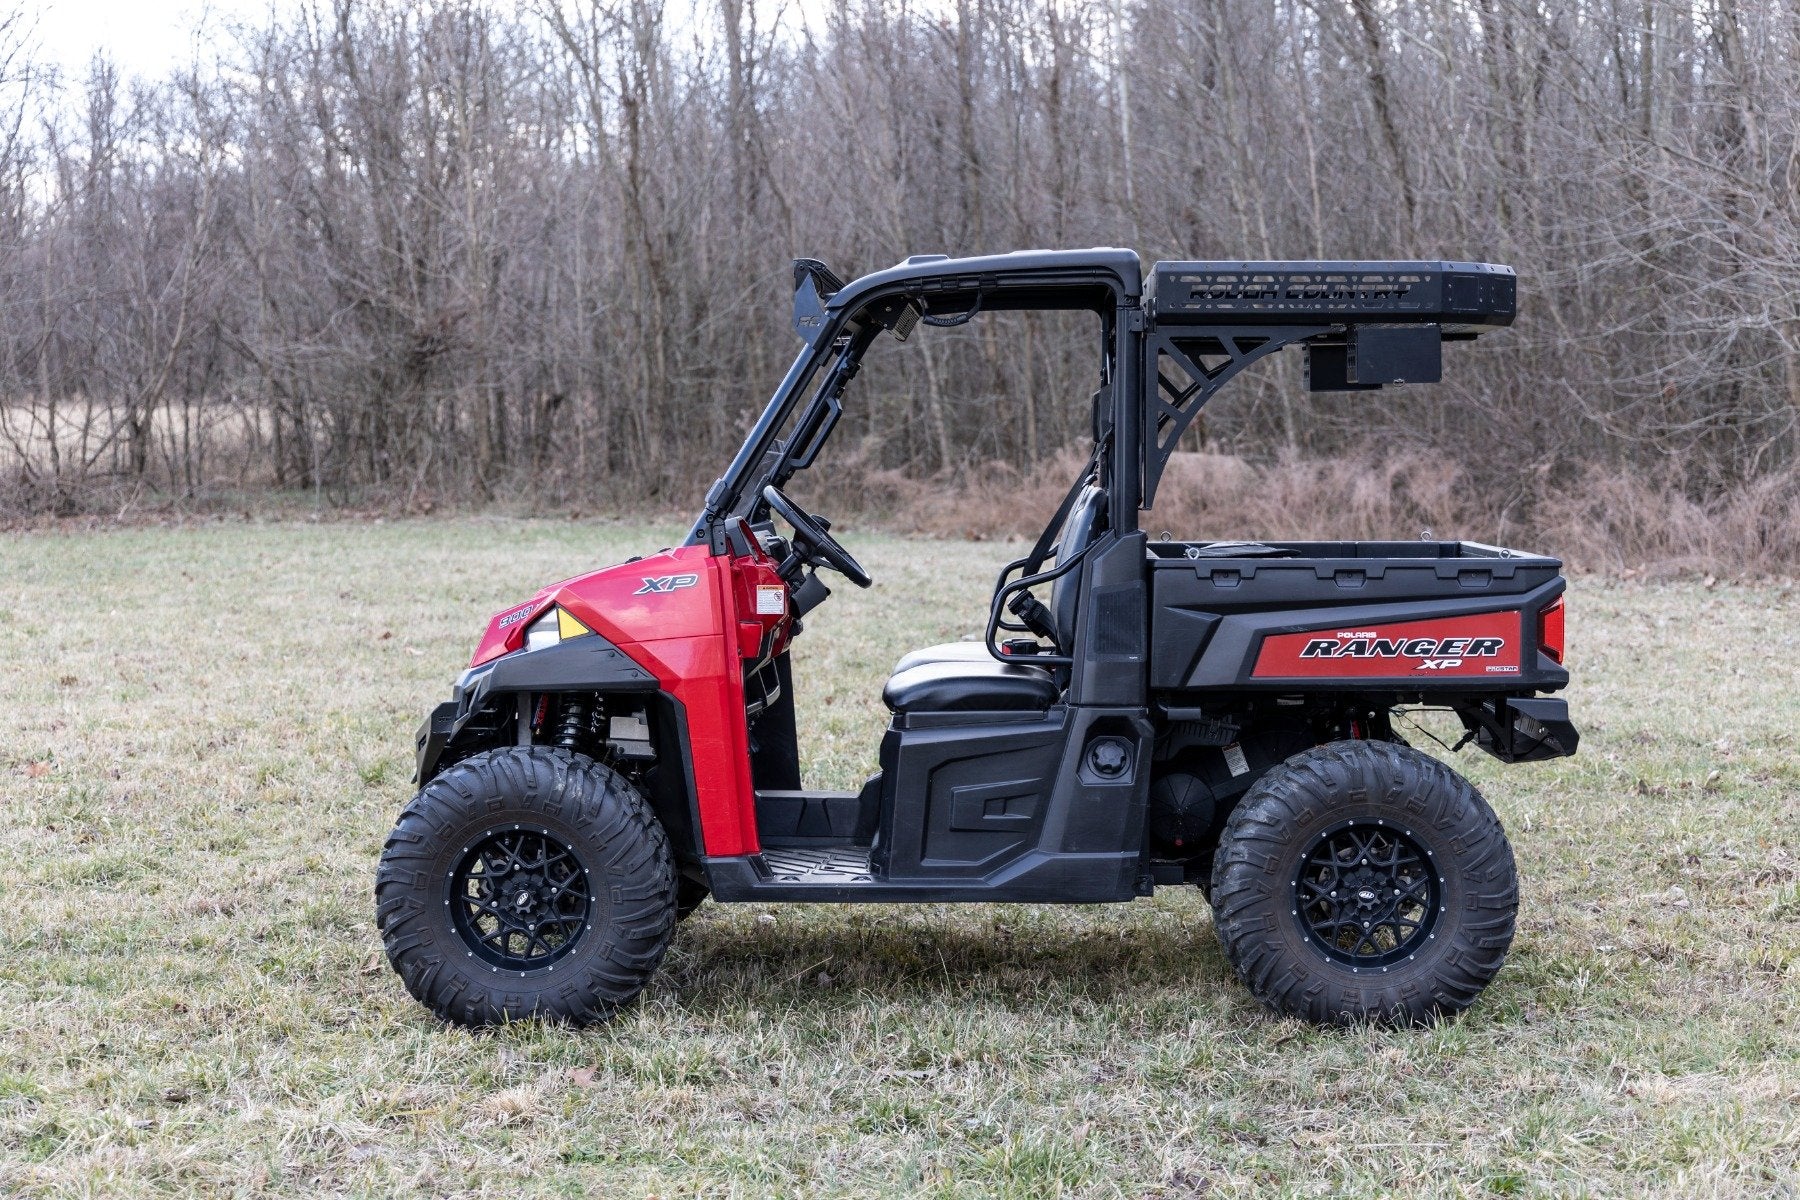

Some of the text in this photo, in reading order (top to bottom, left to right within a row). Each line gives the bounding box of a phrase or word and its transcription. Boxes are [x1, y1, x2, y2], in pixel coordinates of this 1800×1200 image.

[1189, 284, 1411, 300] ROUGH COUNTRY
[632, 574, 699, 595] XP
[499, 604, 534, 629] 900
[1299, 637, 1504, 658] RANGER
[1414, 659, 1462, 670] XP
